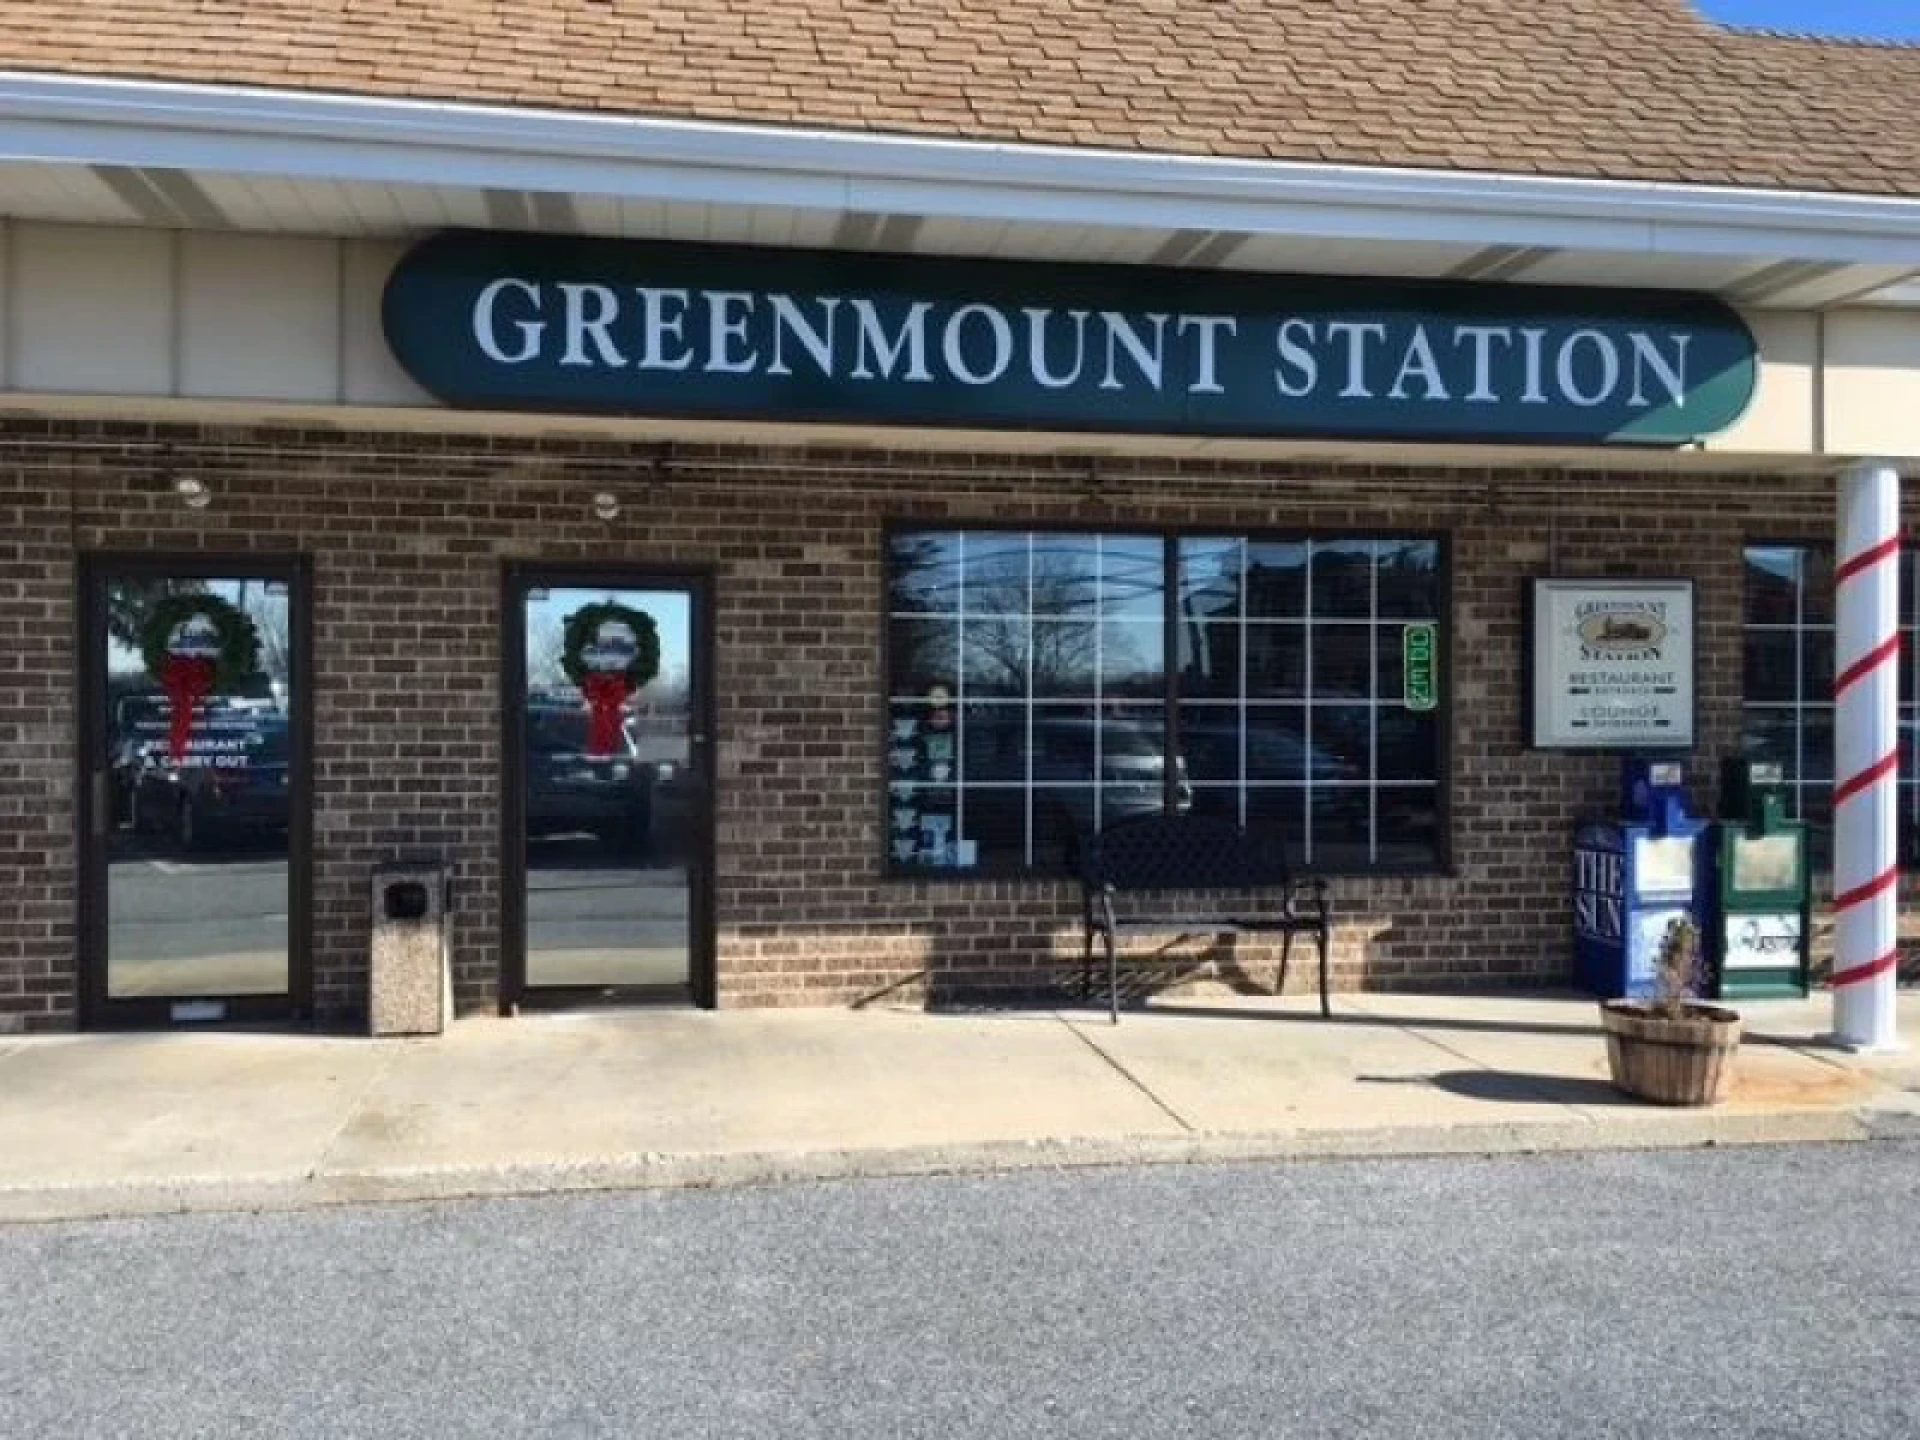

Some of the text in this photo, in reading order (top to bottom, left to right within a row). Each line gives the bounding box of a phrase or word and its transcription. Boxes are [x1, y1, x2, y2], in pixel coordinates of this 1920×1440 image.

[471, 276, 1692, 409] GREENMOUNT STATION
[1573, 849, 1623, 896] THE
